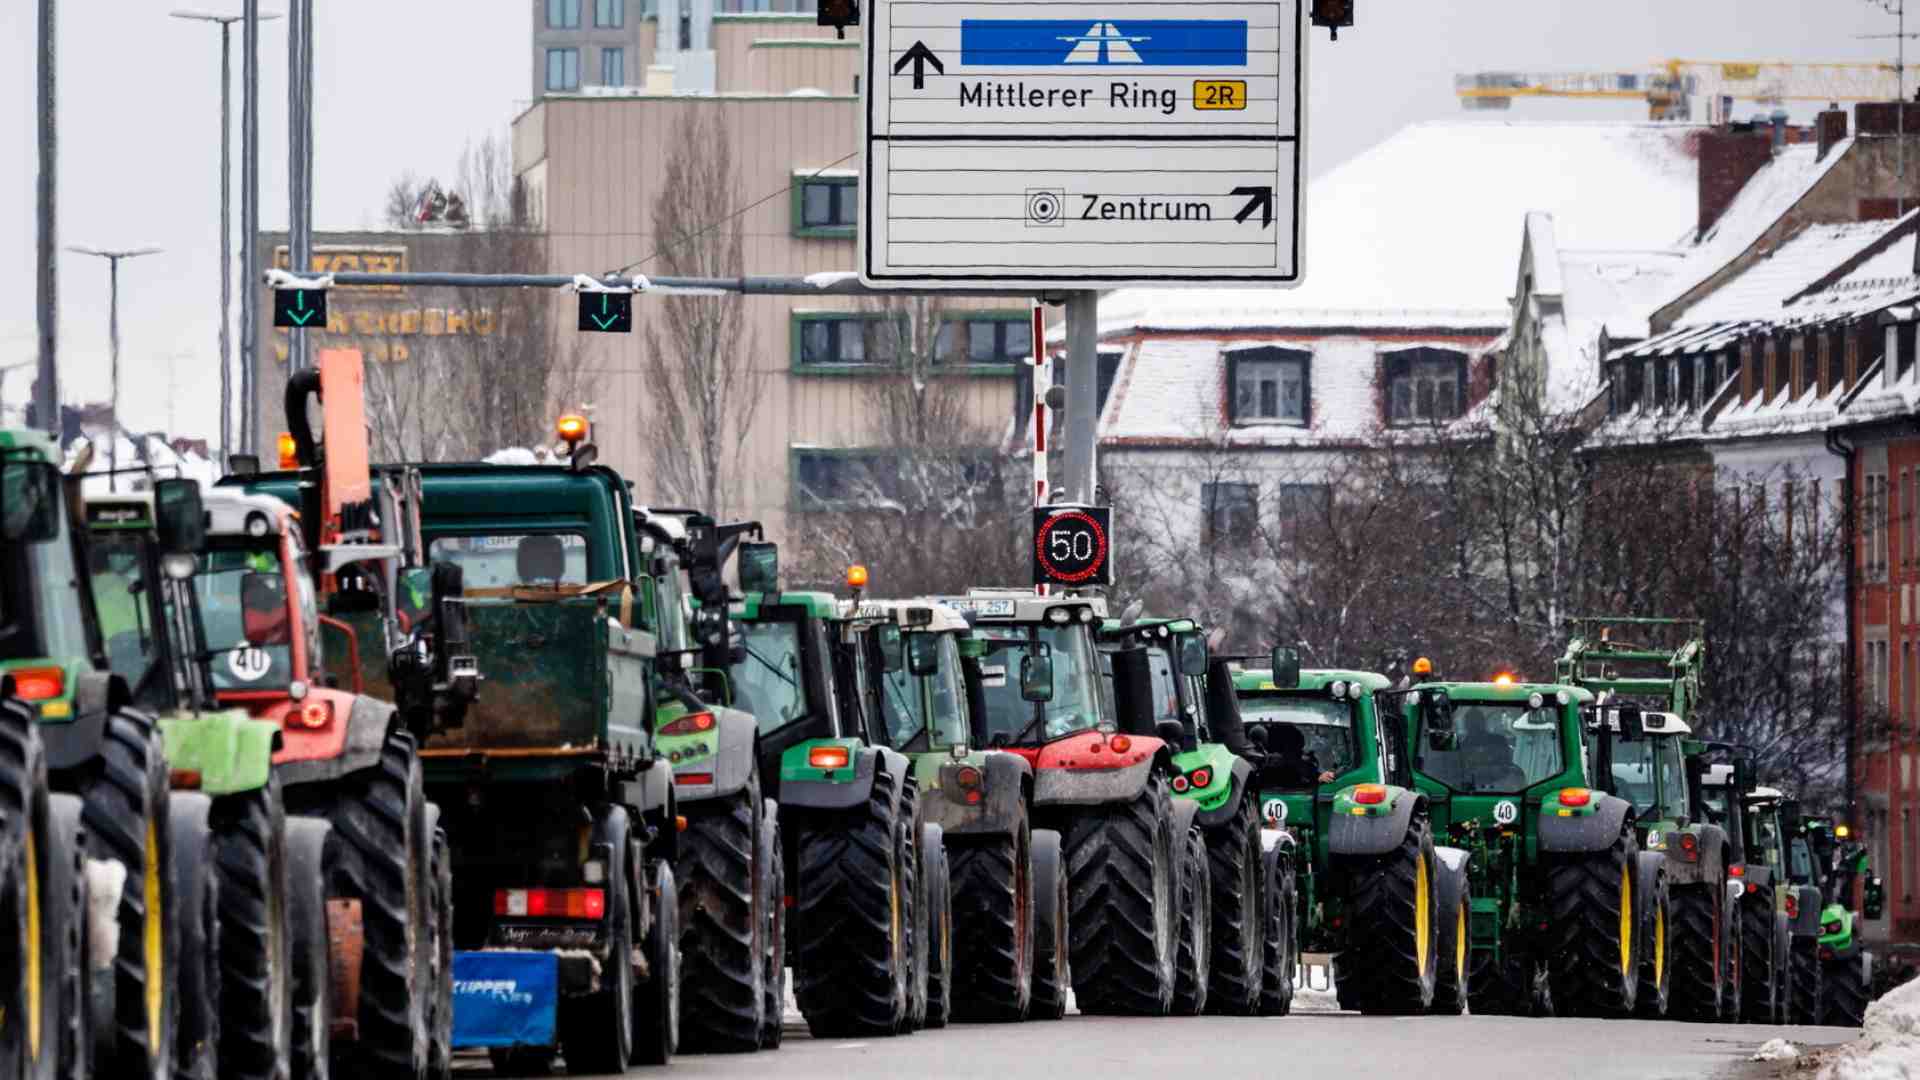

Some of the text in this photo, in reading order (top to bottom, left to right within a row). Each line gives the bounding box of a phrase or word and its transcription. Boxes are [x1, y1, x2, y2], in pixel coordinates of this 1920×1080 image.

[959, 82, 1236, 115] Mittlerer Ring 2R
[1081, 194, 1211, 221] Zentrum
[1052, 530, 1092, 560] 50
[236, 649, 264, 672] 40
[1268, 803, 1283, 819] 40
[1498, 804, 1512, 820] 40
